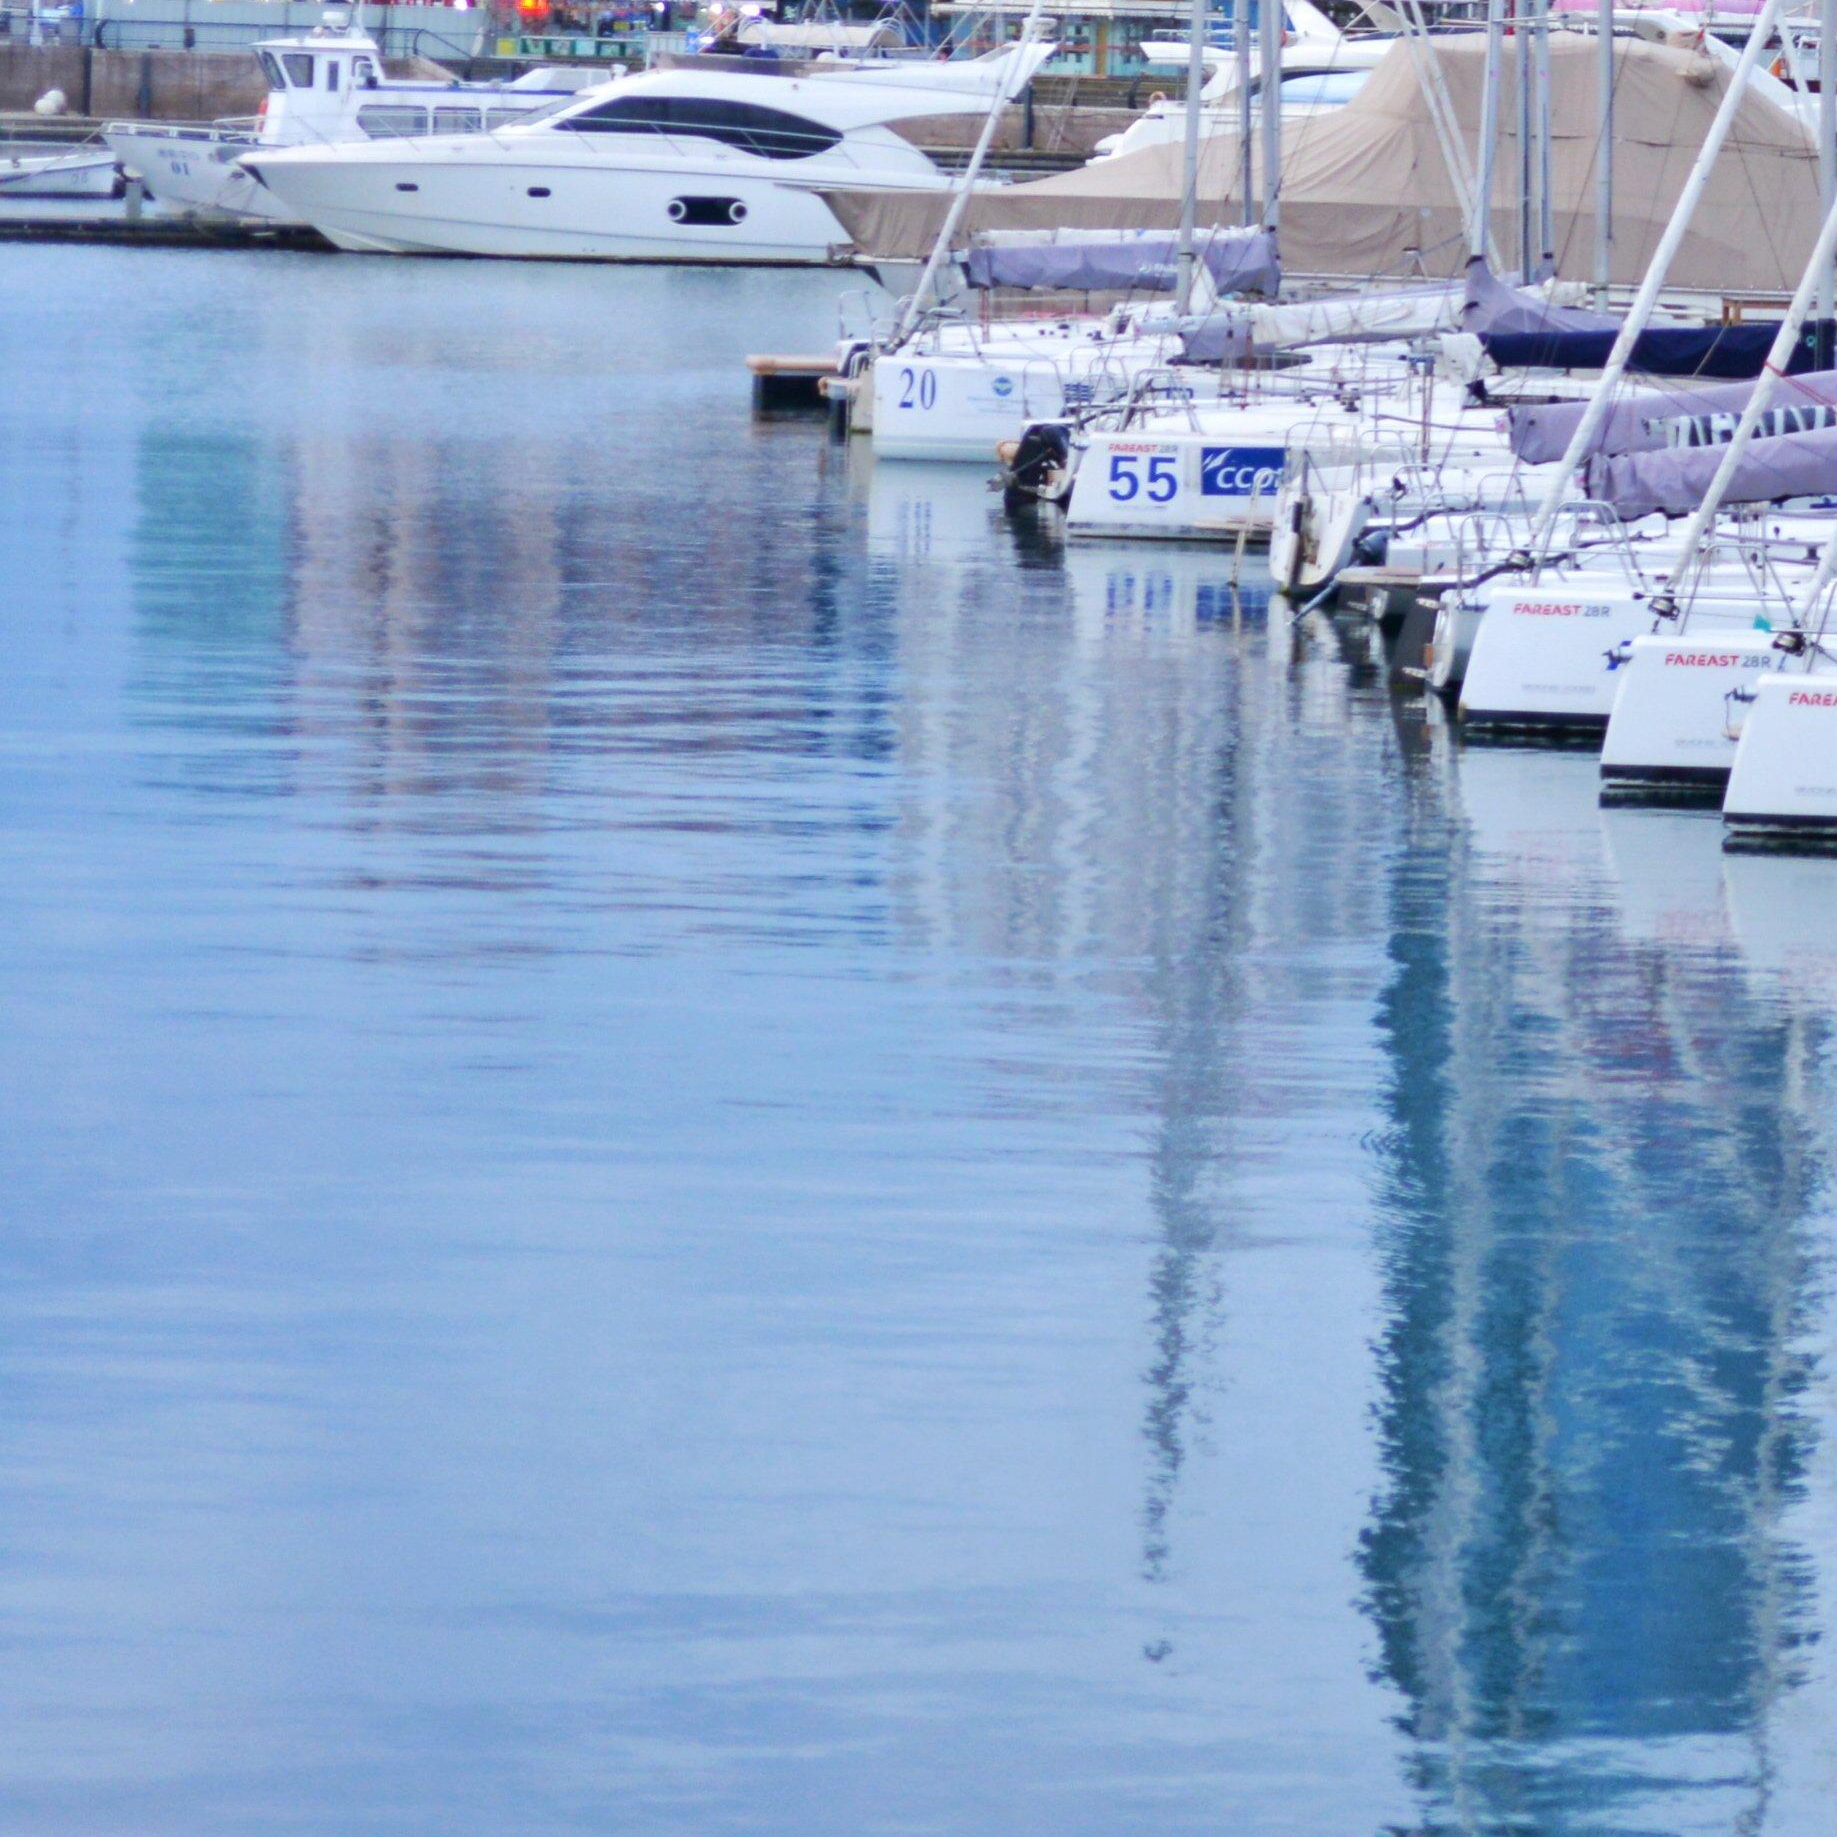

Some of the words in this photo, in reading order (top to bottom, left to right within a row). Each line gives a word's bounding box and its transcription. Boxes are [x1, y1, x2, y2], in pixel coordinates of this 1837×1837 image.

[898, 367, 937, 411] 20
[1108, 443, 1158, 453] FAREAST
[1108, 454, 1178, 503] 55
[1512, 602, 1582, 617] FAREAST
[1584, 604, 1610, 618] 28R
[1664, 652, 1739, 668] FAREAST
[1742, 654, 1771, 669] 28R
